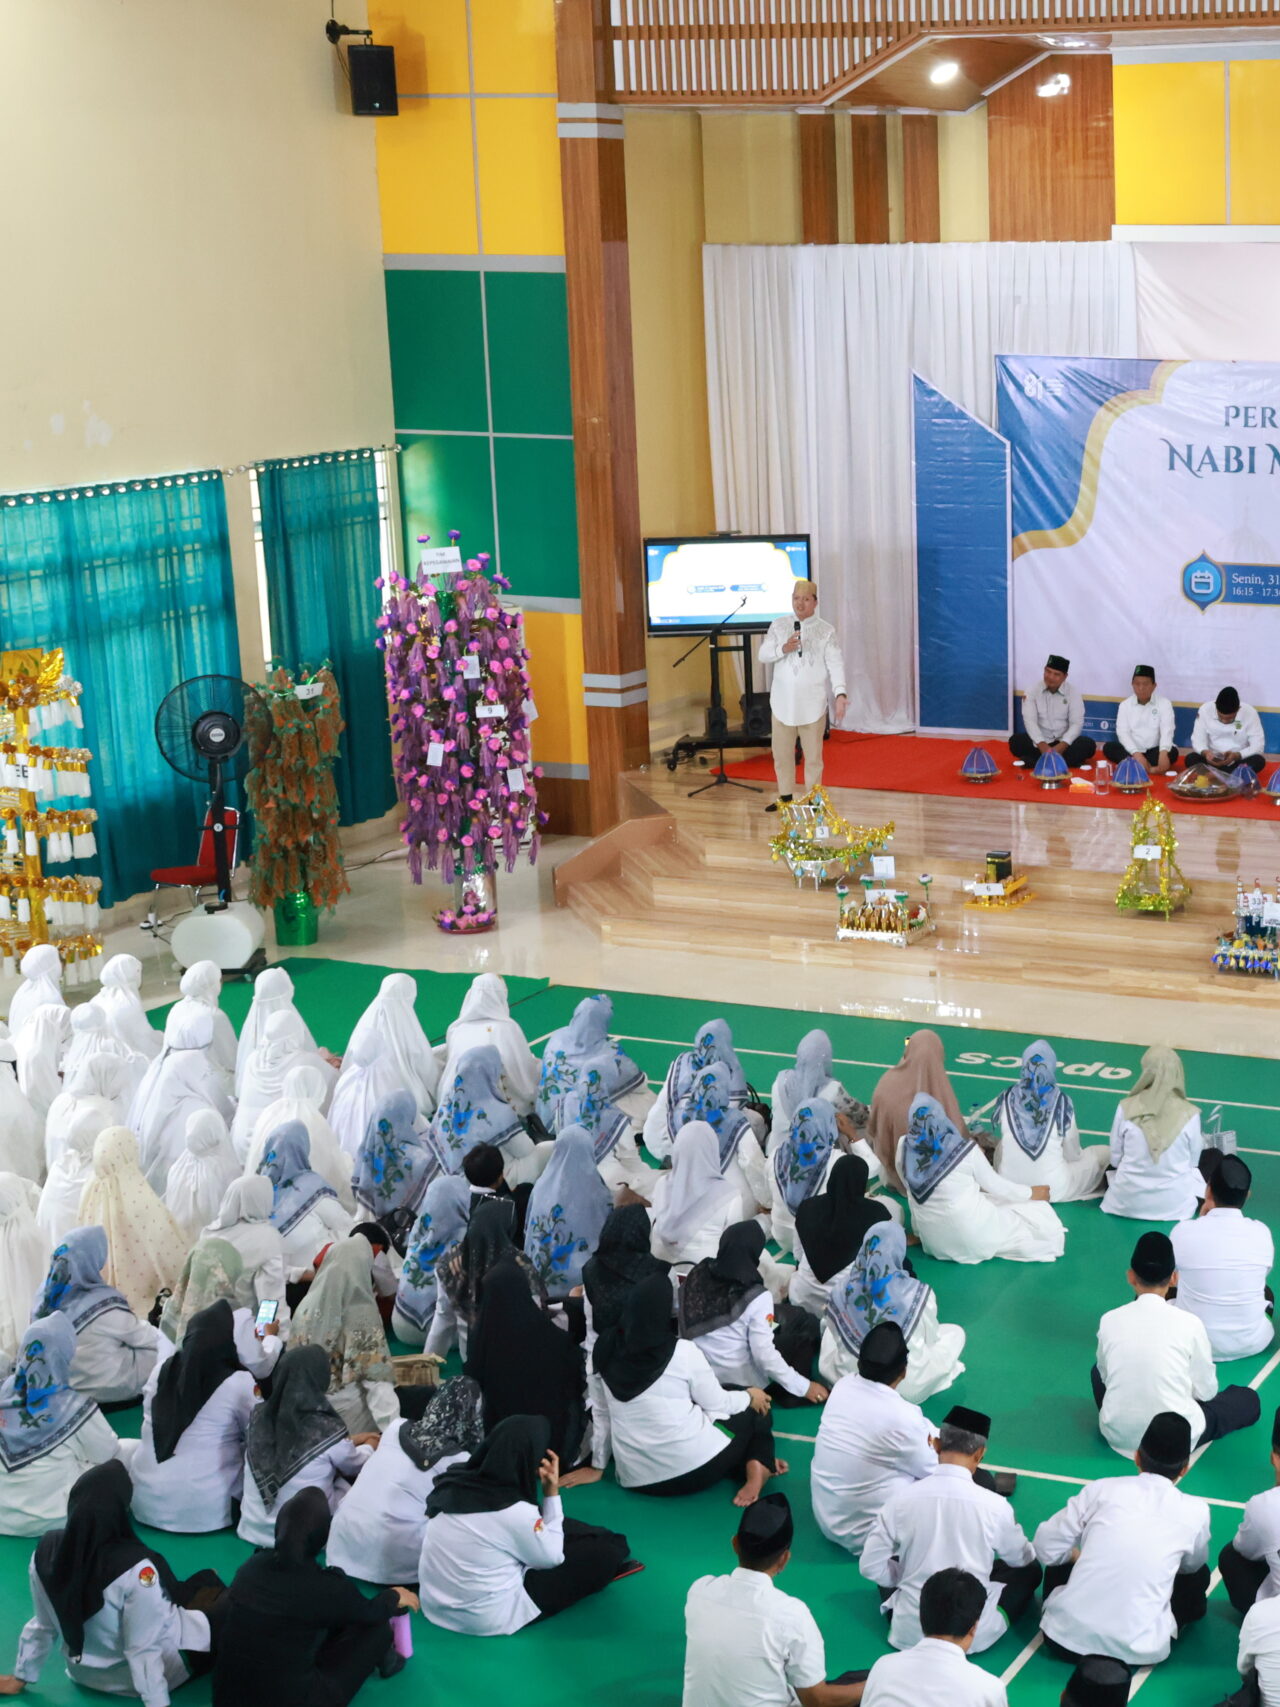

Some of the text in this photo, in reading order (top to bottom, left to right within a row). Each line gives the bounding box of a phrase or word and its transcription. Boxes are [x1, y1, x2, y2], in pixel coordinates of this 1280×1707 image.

[1159, 438, 1257, 479] NABI
[1232, 572, 1265, 586] Senin,
[1268, 574, 1280, 585] 31
[1232, 587, 1254, 596] 16:15
[955, 1052, 1132, 1079] apcs
